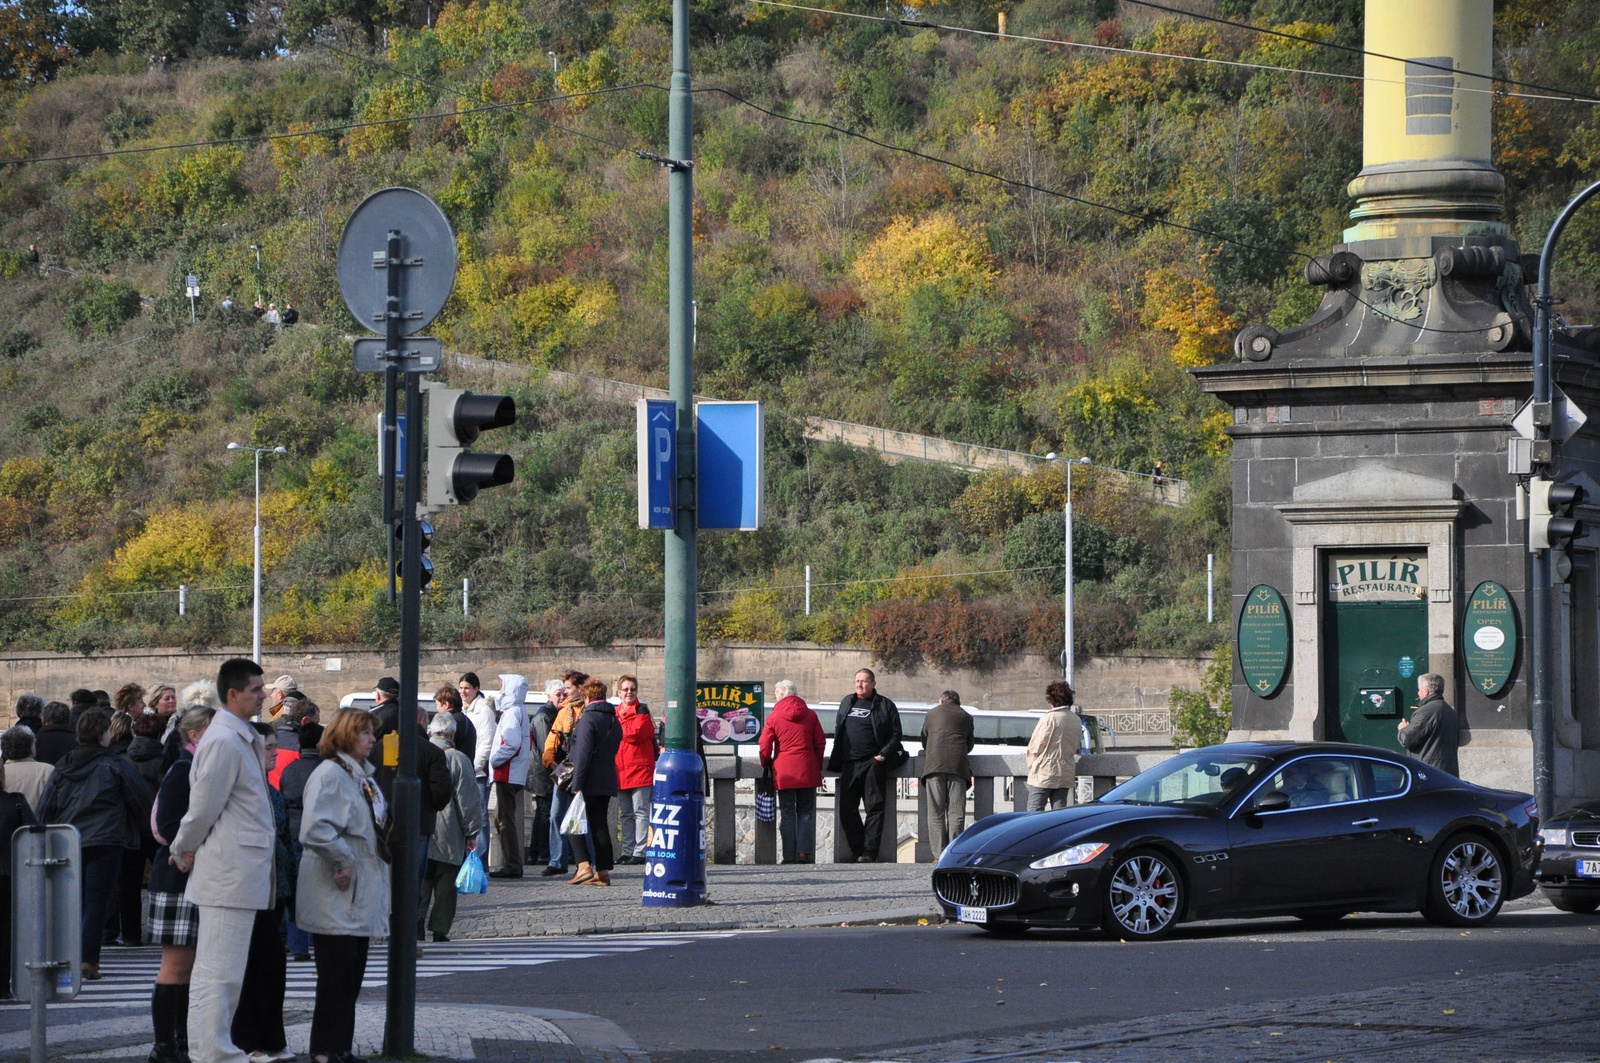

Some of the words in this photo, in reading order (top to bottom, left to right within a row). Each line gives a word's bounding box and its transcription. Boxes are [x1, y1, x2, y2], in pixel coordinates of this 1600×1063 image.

[655, 427, 672, 480] P
[1337, 555, 1421, 586] PILÍŘ
[1247, 602, 1280, 614] PILÍŘ
[1473, 597, 1507, 610] PILÍŘ
[972, 910, 985, 920] 2222
